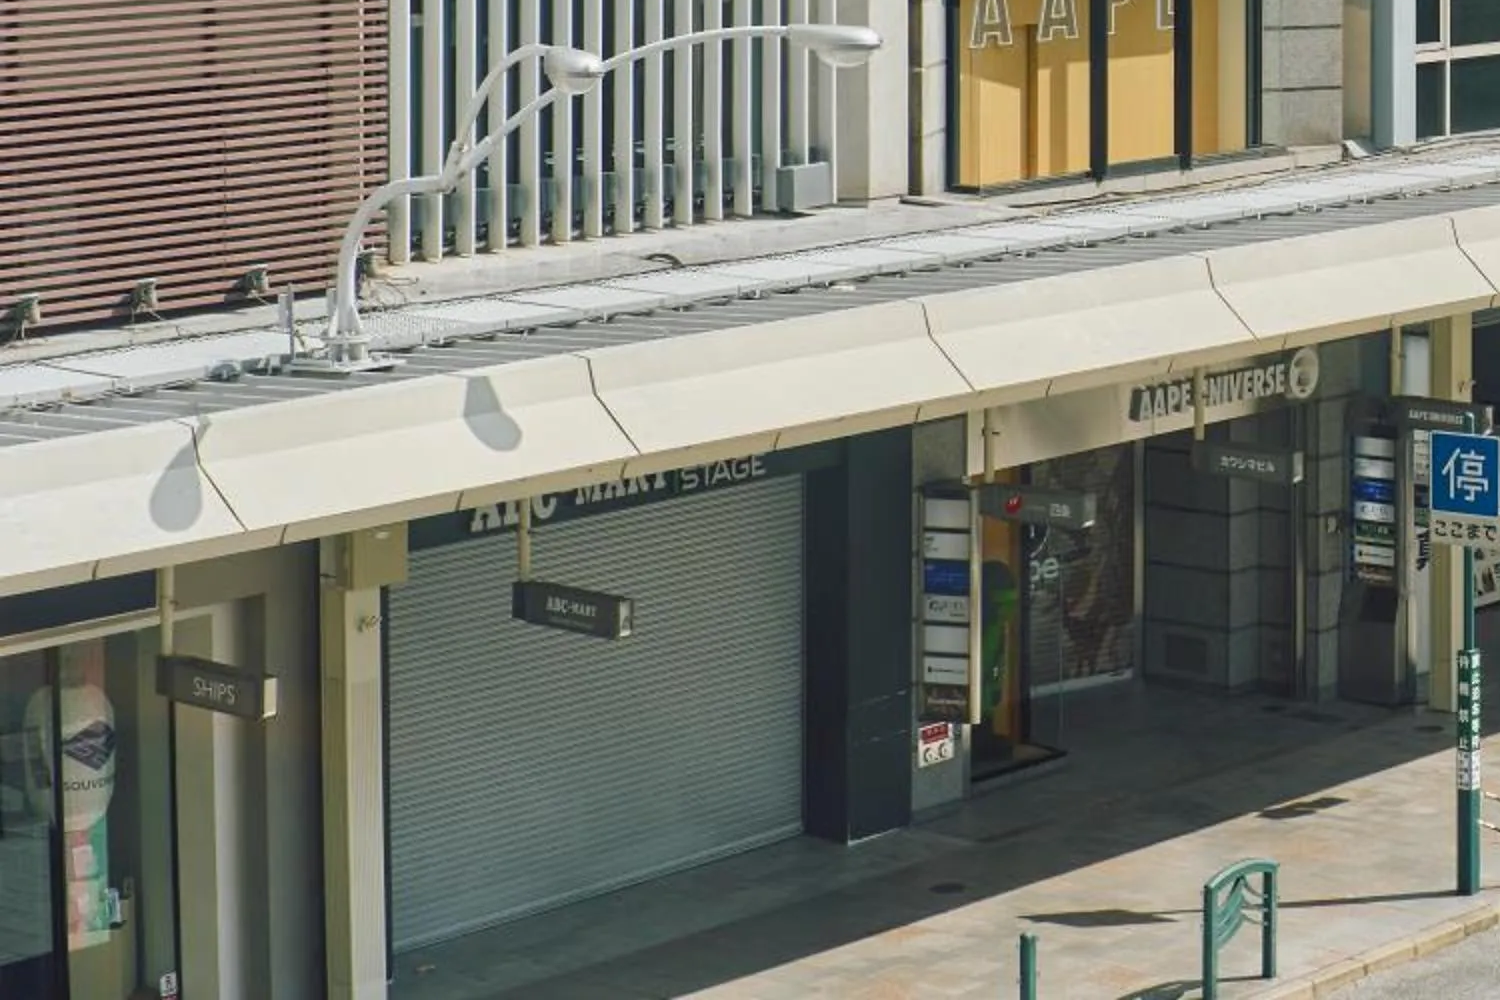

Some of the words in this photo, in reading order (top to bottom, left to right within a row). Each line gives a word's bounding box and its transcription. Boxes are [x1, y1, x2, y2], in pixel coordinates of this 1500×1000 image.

[1137, 379, 1191, 421] AAPE
[681, 454, 767, 490] STAGE
[1441, 447, 1489, 502] 停
[1434, 519, 1498, 541] ここまで
[192, 677, 236, 705] SHIPS
